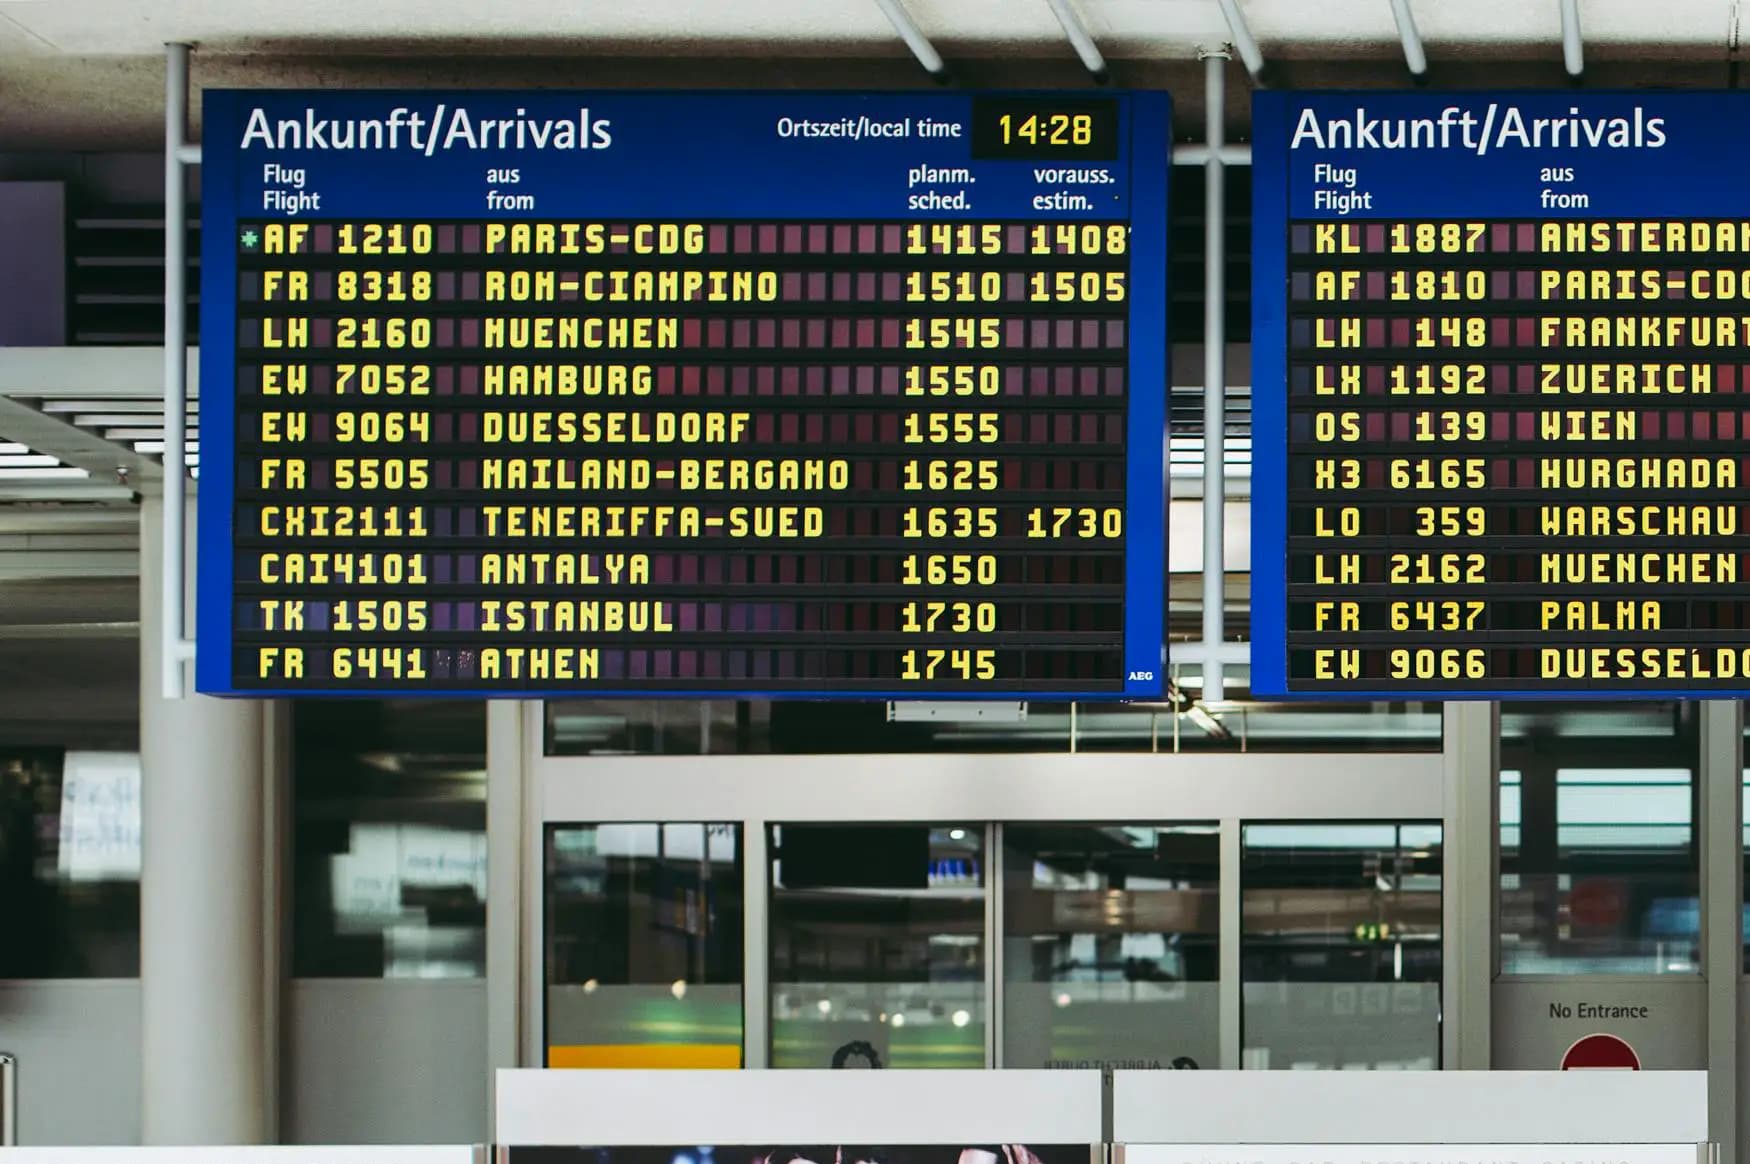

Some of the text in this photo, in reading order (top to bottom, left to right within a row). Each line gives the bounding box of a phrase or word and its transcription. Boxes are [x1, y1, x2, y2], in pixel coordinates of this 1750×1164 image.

[240, 104, 611, 156] Ankunft/Arrivals
[777, 117, 961, 140] Ortszeit/local time
[1000, 115, 1091, 145] 14:28
[1291, 104, 1666, 156] Ankunft/Arrivals
[263, 164, 1115, 187] Flug aus planm. vorauss.
[1314, 164, 1357, 186] Flug
[1541, 166, 1574, 182] aus
[263, 190, 1093, 214] Flight from sched. estim.
[1314, 190, 1372, 213] Flight
[1541, 190, 1588, 209] from
[264, 223, 1126, 255] AF 1210 PARIS-CDG 1415 1408
[1316, 224, 1361, 254] KL
[1391, 223, 1486, 253] 1887
[264, 271, 1125, 302] FR 8318 ROM-CIAMPINO 1510 1505
[260, 600, 996, 633] TK 1505 ISTANBUL 1730
[1316, 602, 1360, 632] FR
[1391, 601, 1485, 631] 6437
[1541, 601, 1660, 631] PALMA
[1128, 671, 1153, 681] AEG
[1550, 1004, 1648, 1019] No Entrance
